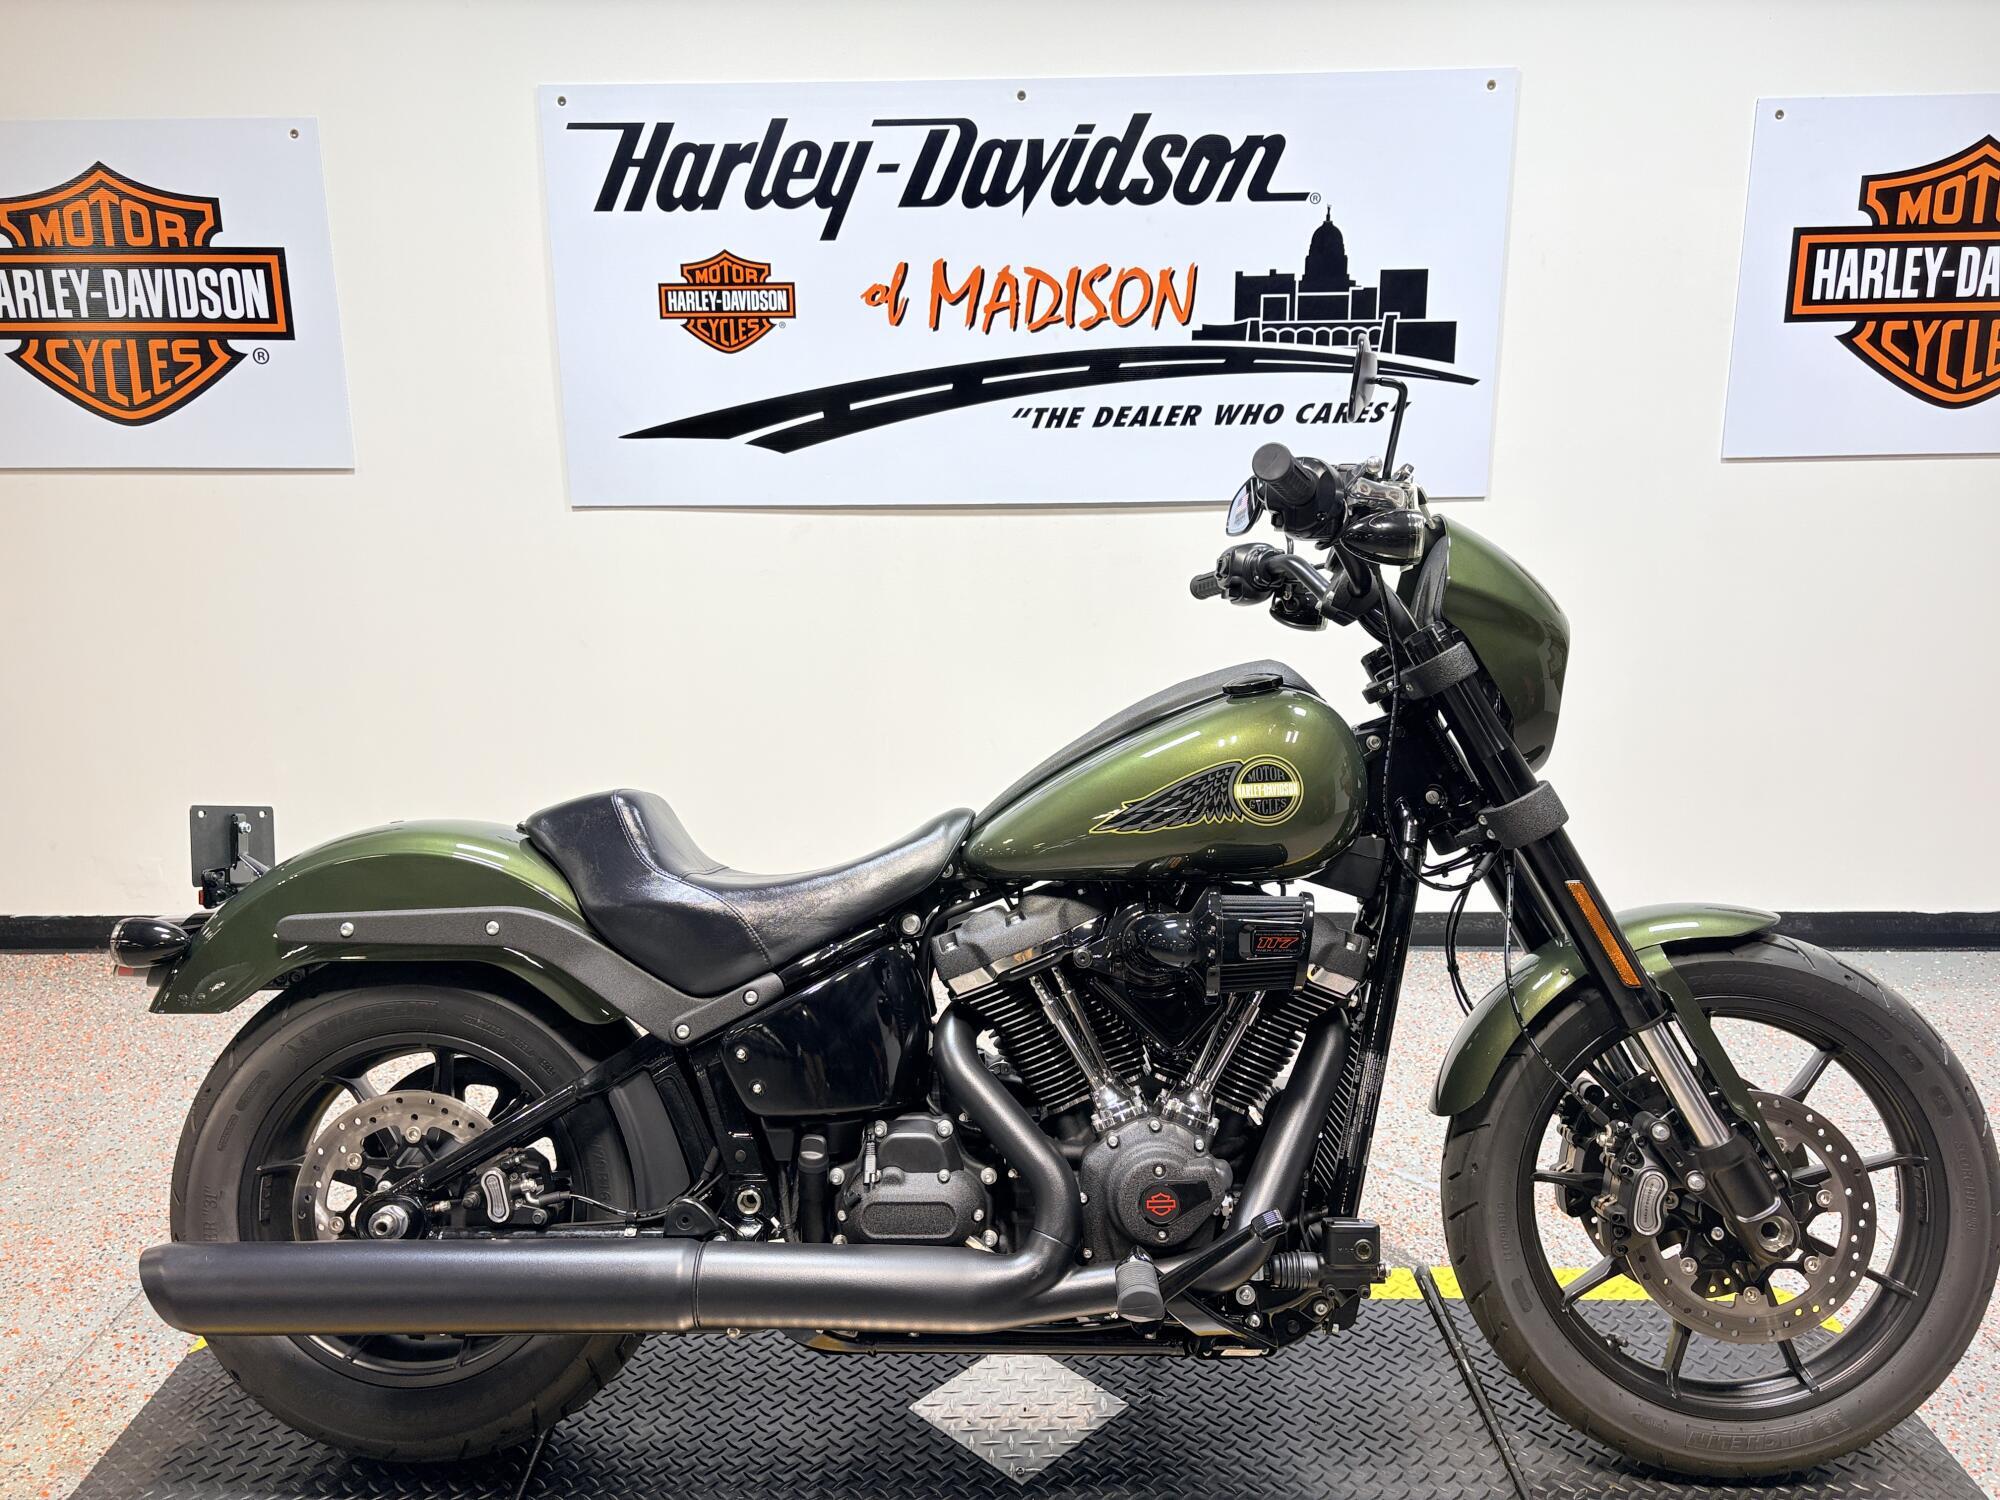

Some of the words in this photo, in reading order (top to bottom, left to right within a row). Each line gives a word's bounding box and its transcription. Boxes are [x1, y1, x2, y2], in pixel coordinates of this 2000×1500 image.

[566, 113, 1310, 240] Harley-Davidson
[1896, 162, 2000, 225] MOT
[29, 187, 188, 247] MOTOR
[0, 268, 270, 319] ARLEY-DAVIDSON
[695, 260, 758, 283] MOTOR
[929, 258, 1198, 335] MADISON
[1812, 246, 2000, 300] HARLEY-DA
[667, 290, 788, 312] HARLEY-DAVIDSON
[697, 318, 760, 347] CYCLES
[1881, 319, 2000, 390] CYCLE
[46, 339, 202, 407] CYCLES
[1092, 405, 1202, 428] DEALER
[1214, 404, 1285, 426] WHO
[1248, 766, 1286, 782] MOTOR
[1249, 798, 1287, 814] CYCLES
[1257, 936, 1299, 948] 117
